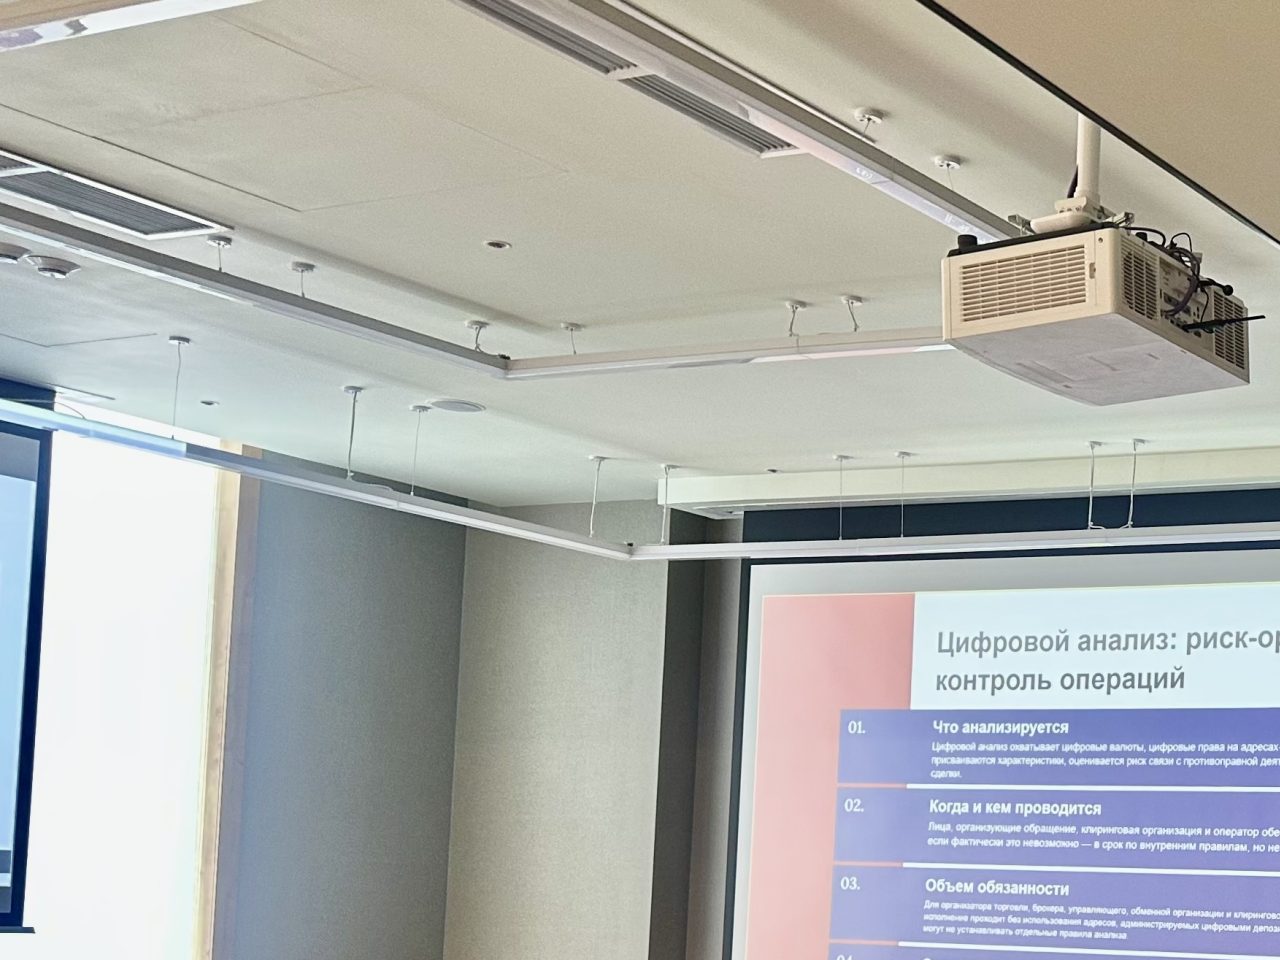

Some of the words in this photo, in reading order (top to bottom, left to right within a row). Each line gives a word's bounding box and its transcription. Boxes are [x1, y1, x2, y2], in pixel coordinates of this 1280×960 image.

[937, 629, 1070, 658] Цифровой
[1077, 633, 1177, 652] анализ:
[936, 672, 1052, 696] контроль
[1060, 666, 1185, 695] операций
[848, 721, 865, 734] 01.
[933, 719, 959, 734] Что
[961, 722, 1069, 737] анализируется
[932, 740, 976, 754] Цифровой
[977, 743, 1008, 751] анализ
[1009, 743, 1059, 751] охватывает
[1061, 741, 1107, 754] цифровые
[1147, 741, 1196, 754] цифровые
[1197, 743, 1225, 754] права
[1226, 743, 1238, 752] на
[1067, 757, 1124, 767] оценивается
[1125, 757, 1146, 768] риск
[1148, 757, 1174, 765] связи
[1175, 757, 1181, 765] с
[1182, 755, 1258, 768] противоправной
[844, 798, 864, 812] 02.
[929, 799, 969, 816] Когда
[972, 802, 981, 814] и
[985, 802, 1011, 814] кем
[1014, 802, 1101, 818] проводится
[955, 823, 1021, 835] организующие
[1080, 825, 1140, 837] клиринговая
[1141, 826, 1202, 838] организация
[1203, 827, 1211, 836] и
[1212, 827, 1259, 839] оператор
[927, 837, 949, 846] если
[950, 835, 1003, 849] фактически
[1005, 838, 1020, 847] это
[1022, 839, 1079, 848] невозможно
[1093, 840, 1100, 849] в
[1101, 840, 1123, 851] срок
[1124, 841, 1137, 849] по
[1139, 841, 1196, 853] внутренним
[1252, 843, 1265, 852] но
[1267, 843, 1280, 852] не
[840, 876, 860, 890] 03.
[925, 878, 974, 893] Объем
[977, 879, 1069, 895] обязанности
[924, 898, 939, 909] Для
[1129, 905, 1170, 917] обменной
[1172, 908, 1224, 921] организации
[1225, 910, 1231, 919] и
[923, 924, 944, 936] могут
[945, 925, 955, 934] не
[1014, 927, 1057, 939] отдельные
[1058, 929, 1092, 941] правила
[969, 914, 1005, 926] проходит
[1006, 913, 1021, 924] без
[1200, 920, 1251, 935] цифровыми
